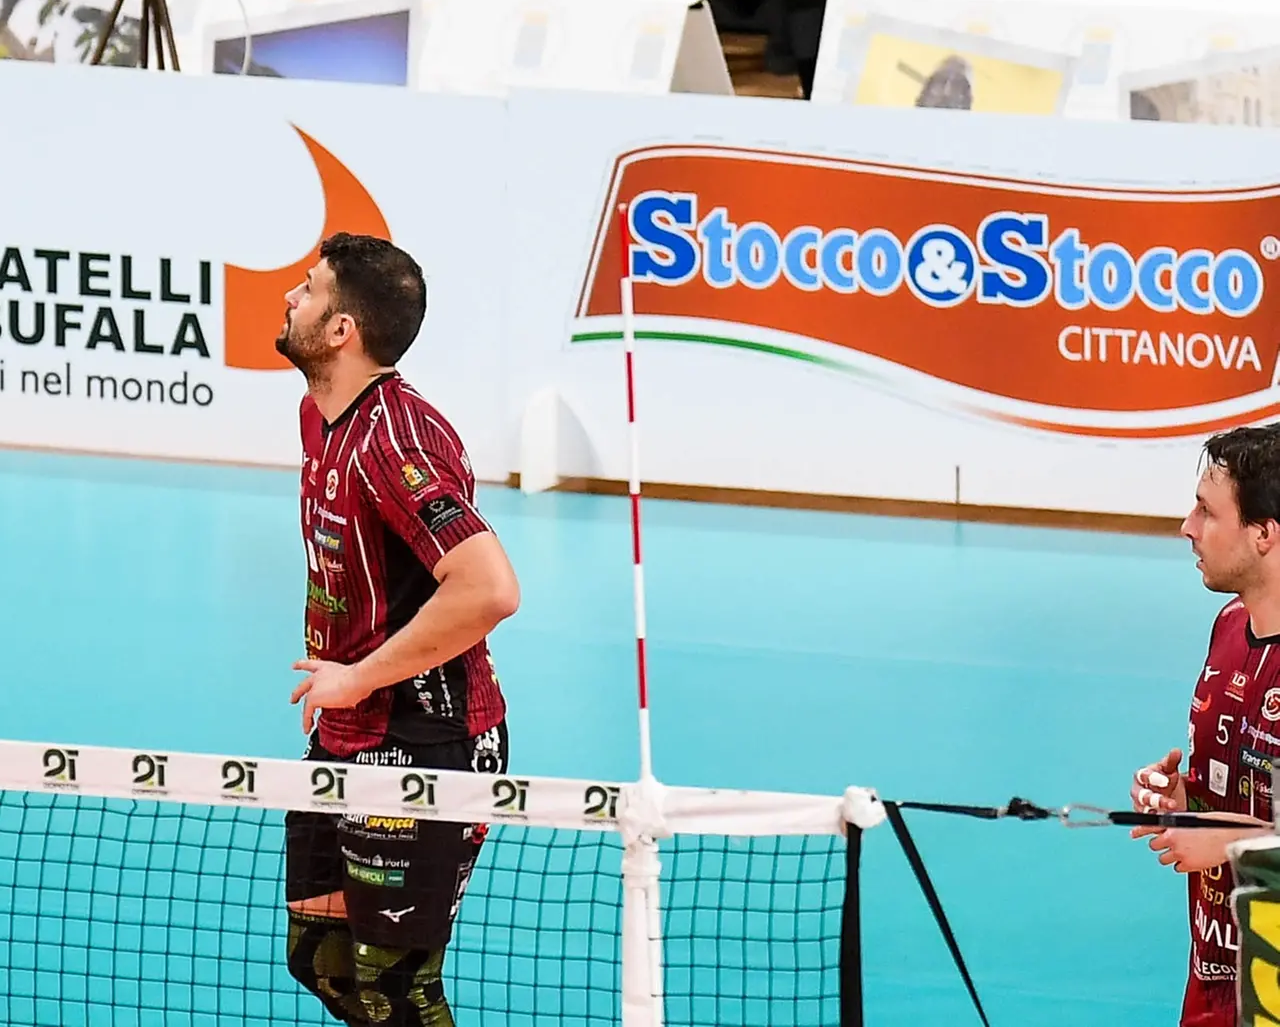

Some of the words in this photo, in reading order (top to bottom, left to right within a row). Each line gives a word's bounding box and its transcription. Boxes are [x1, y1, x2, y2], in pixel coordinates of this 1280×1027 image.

[1058, 325, 1262, 373] CITTANOVA
[21, 362, 71, 397] nel
[86, 368, 215, 408] mondo
[1215, 714, 1234, 745] 5
